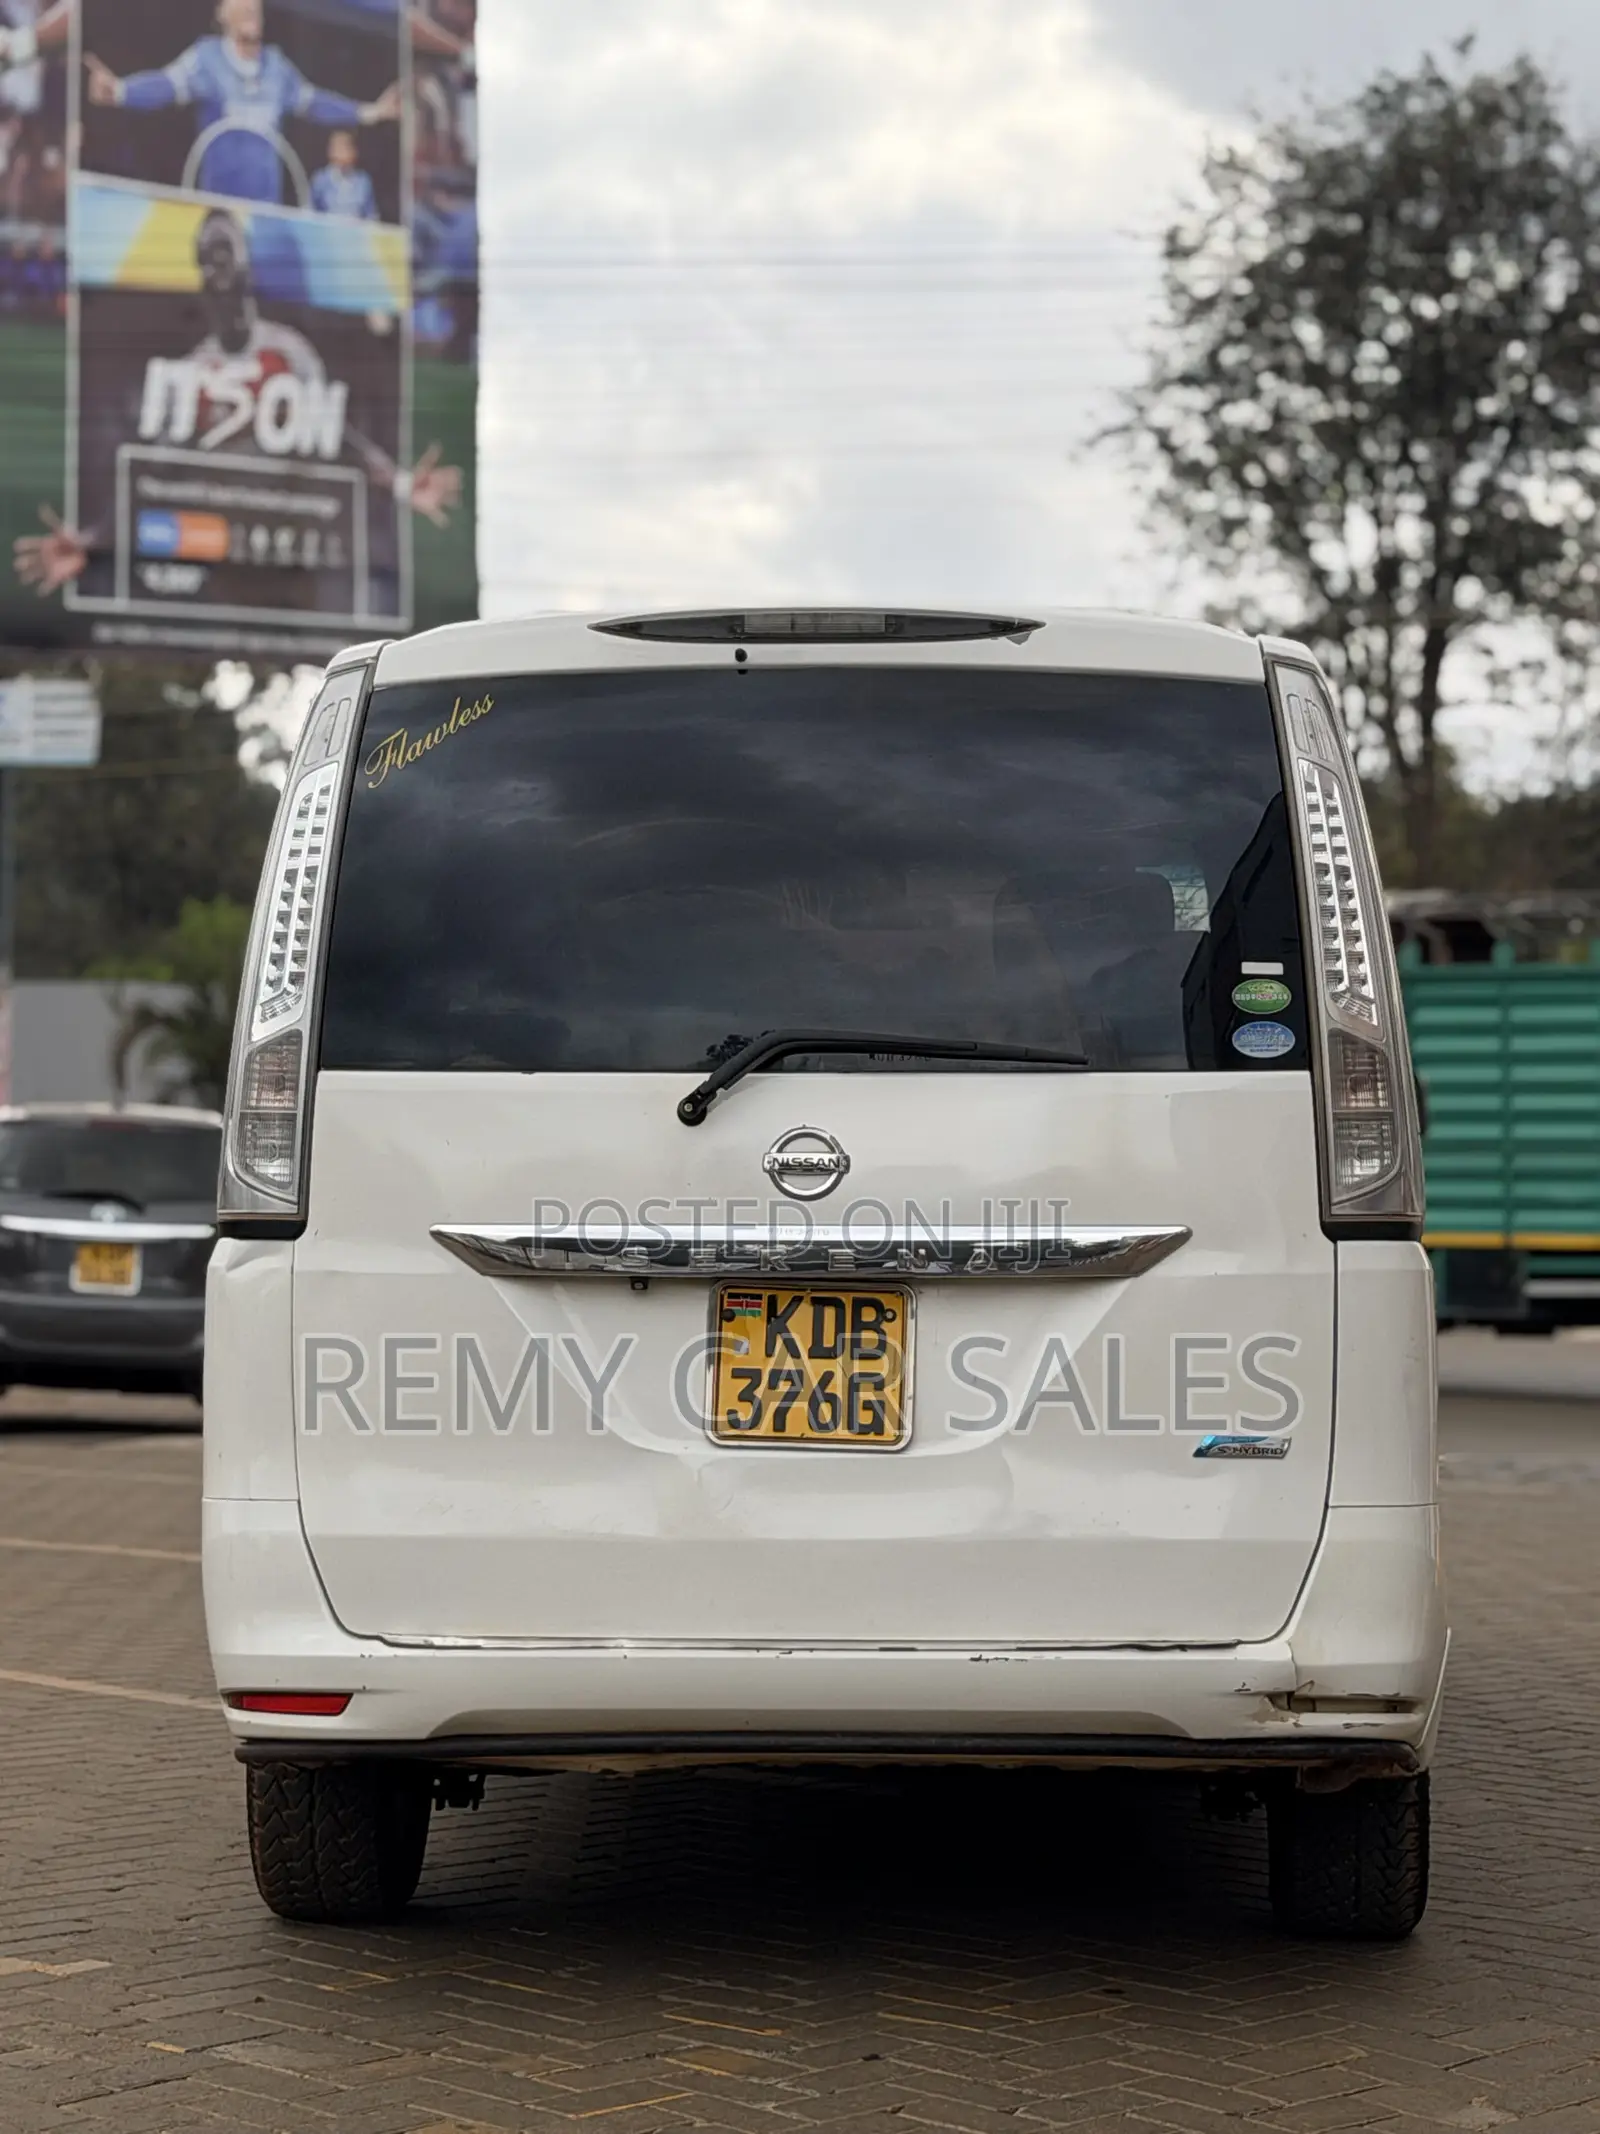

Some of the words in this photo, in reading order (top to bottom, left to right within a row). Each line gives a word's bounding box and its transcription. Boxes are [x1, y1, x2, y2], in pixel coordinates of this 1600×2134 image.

[364, 692, 495, 789] Flawless
[772, 1156, 840, 1169] NISSAN
[620, 1246, 998, 1273] SERENA
[764, 1293, 888, 1360] KDB
[725, 1367, 886, 1436] 376G
